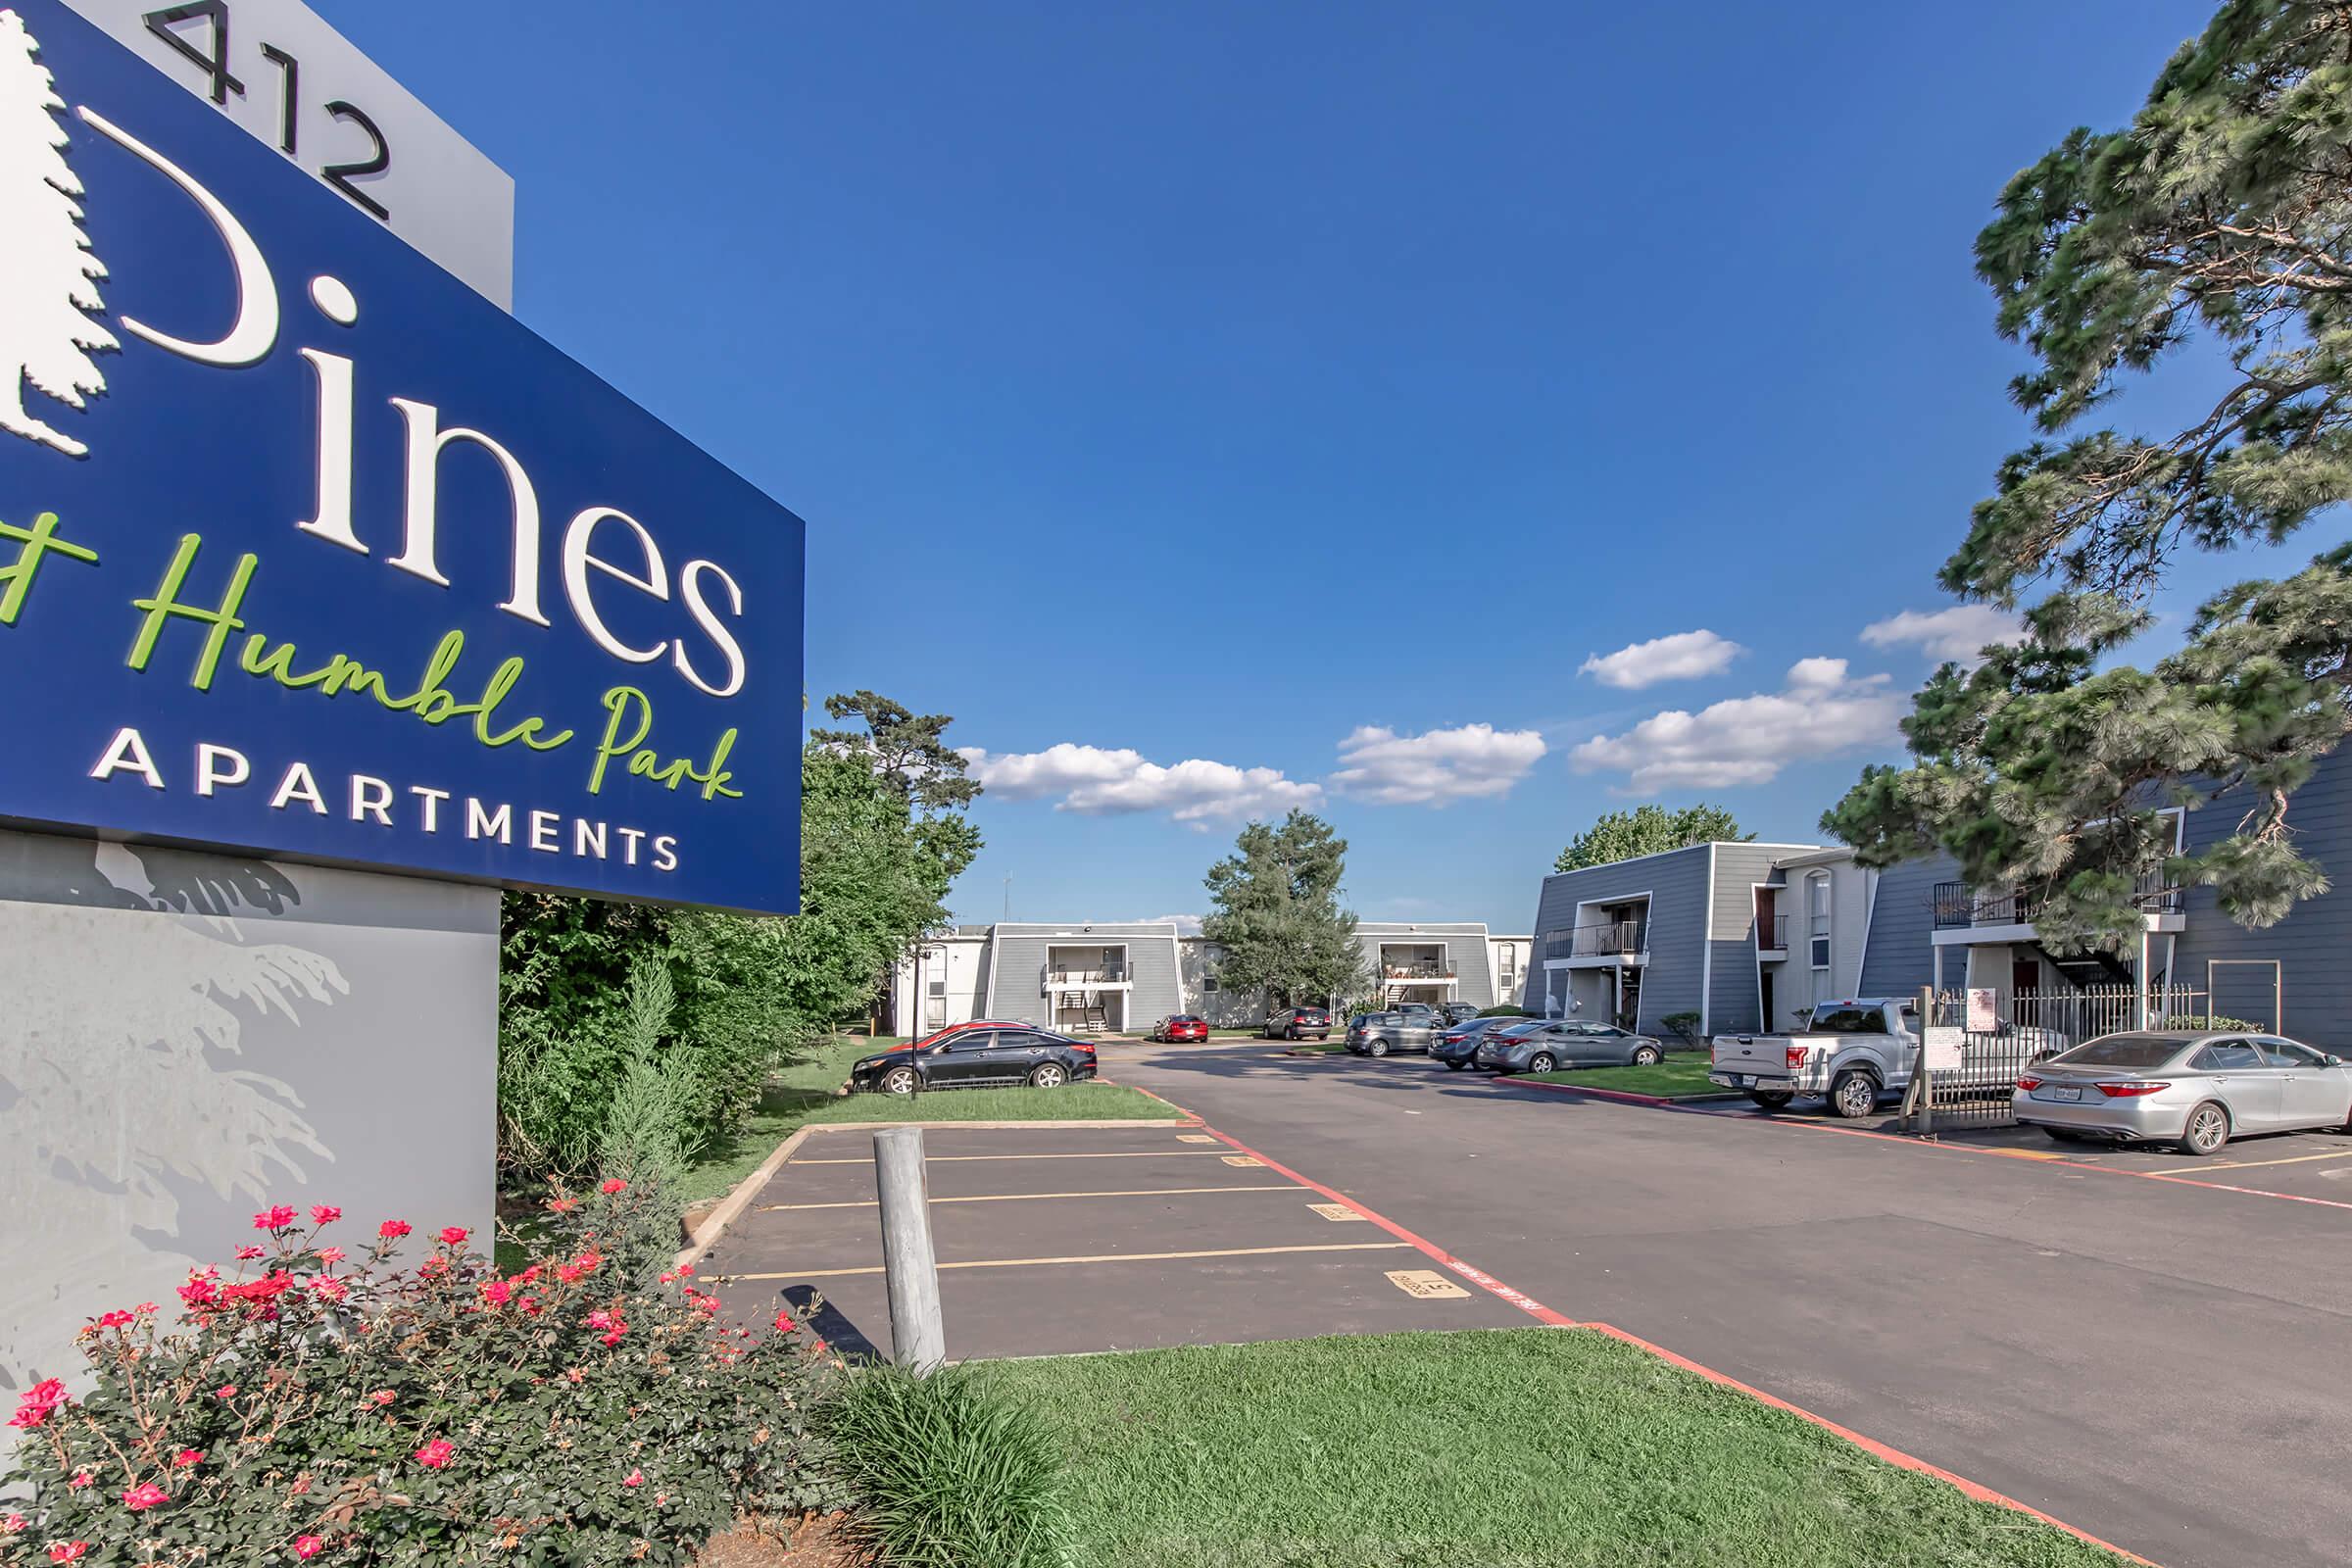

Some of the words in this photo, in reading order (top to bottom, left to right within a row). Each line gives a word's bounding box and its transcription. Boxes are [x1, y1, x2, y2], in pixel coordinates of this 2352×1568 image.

[141, 0, 391, 220] 412
[0, 512, 99, 623] t
[128, 533, 574, 749] Humble
[590, 686, 744, 801] Park
[91, 728, 678, 872] APARTMENTS
